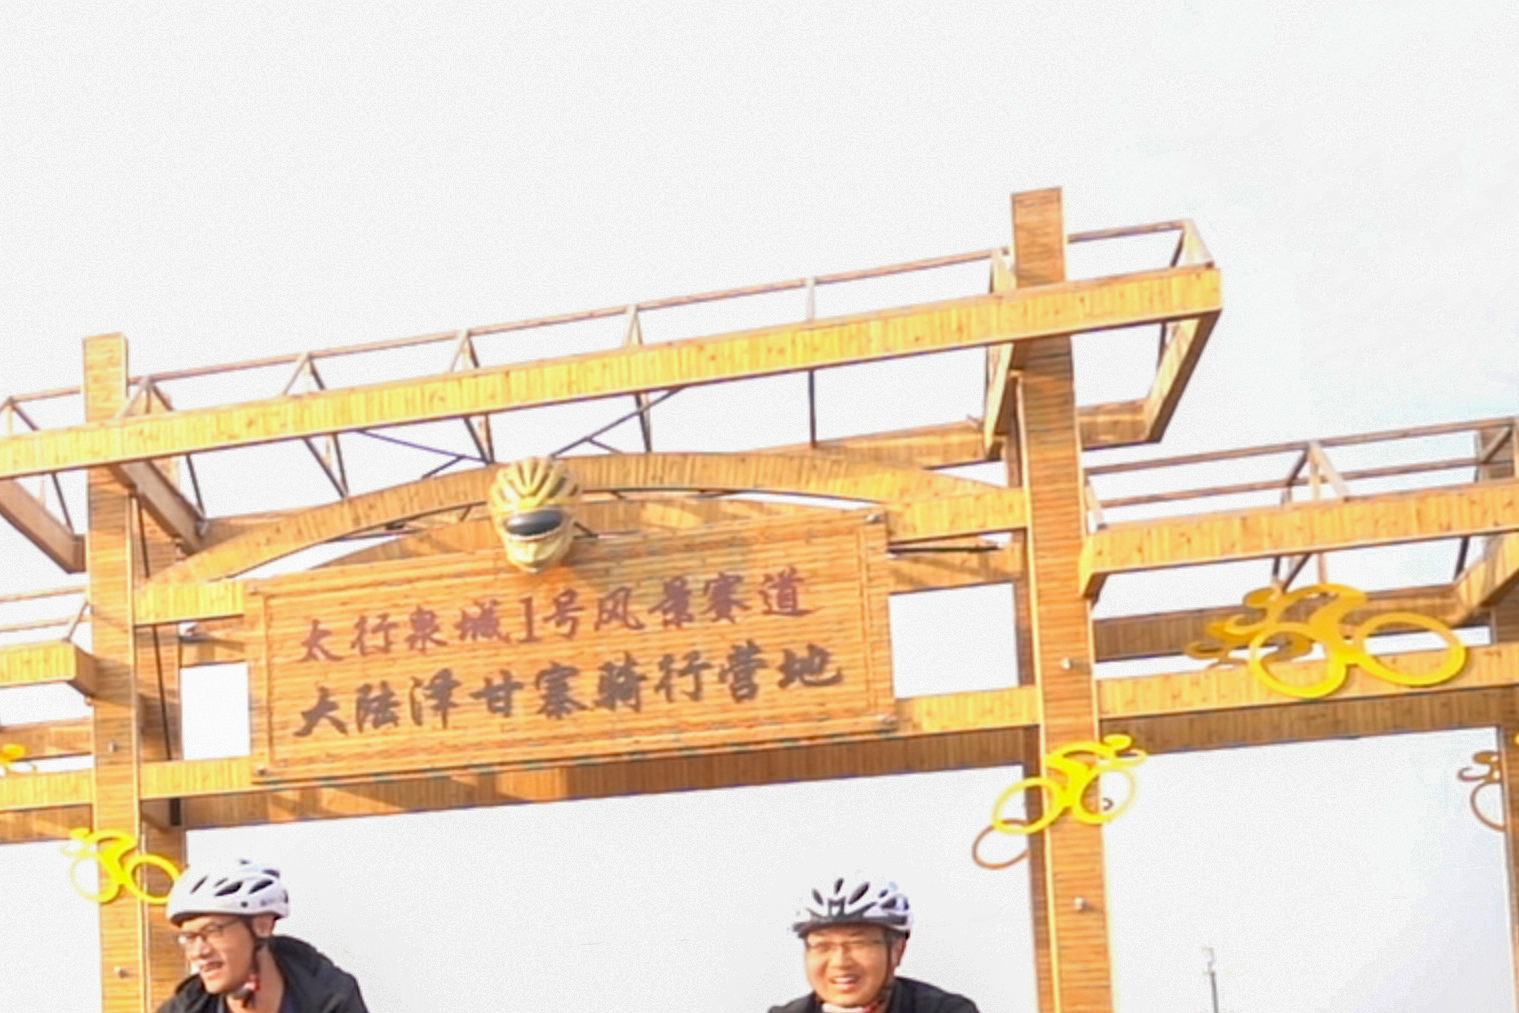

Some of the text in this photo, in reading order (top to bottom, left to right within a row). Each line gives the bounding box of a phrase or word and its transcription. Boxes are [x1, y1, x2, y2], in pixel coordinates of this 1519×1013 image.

[292, 638, 844, 737] 大陆泽甘寨骑行营地
